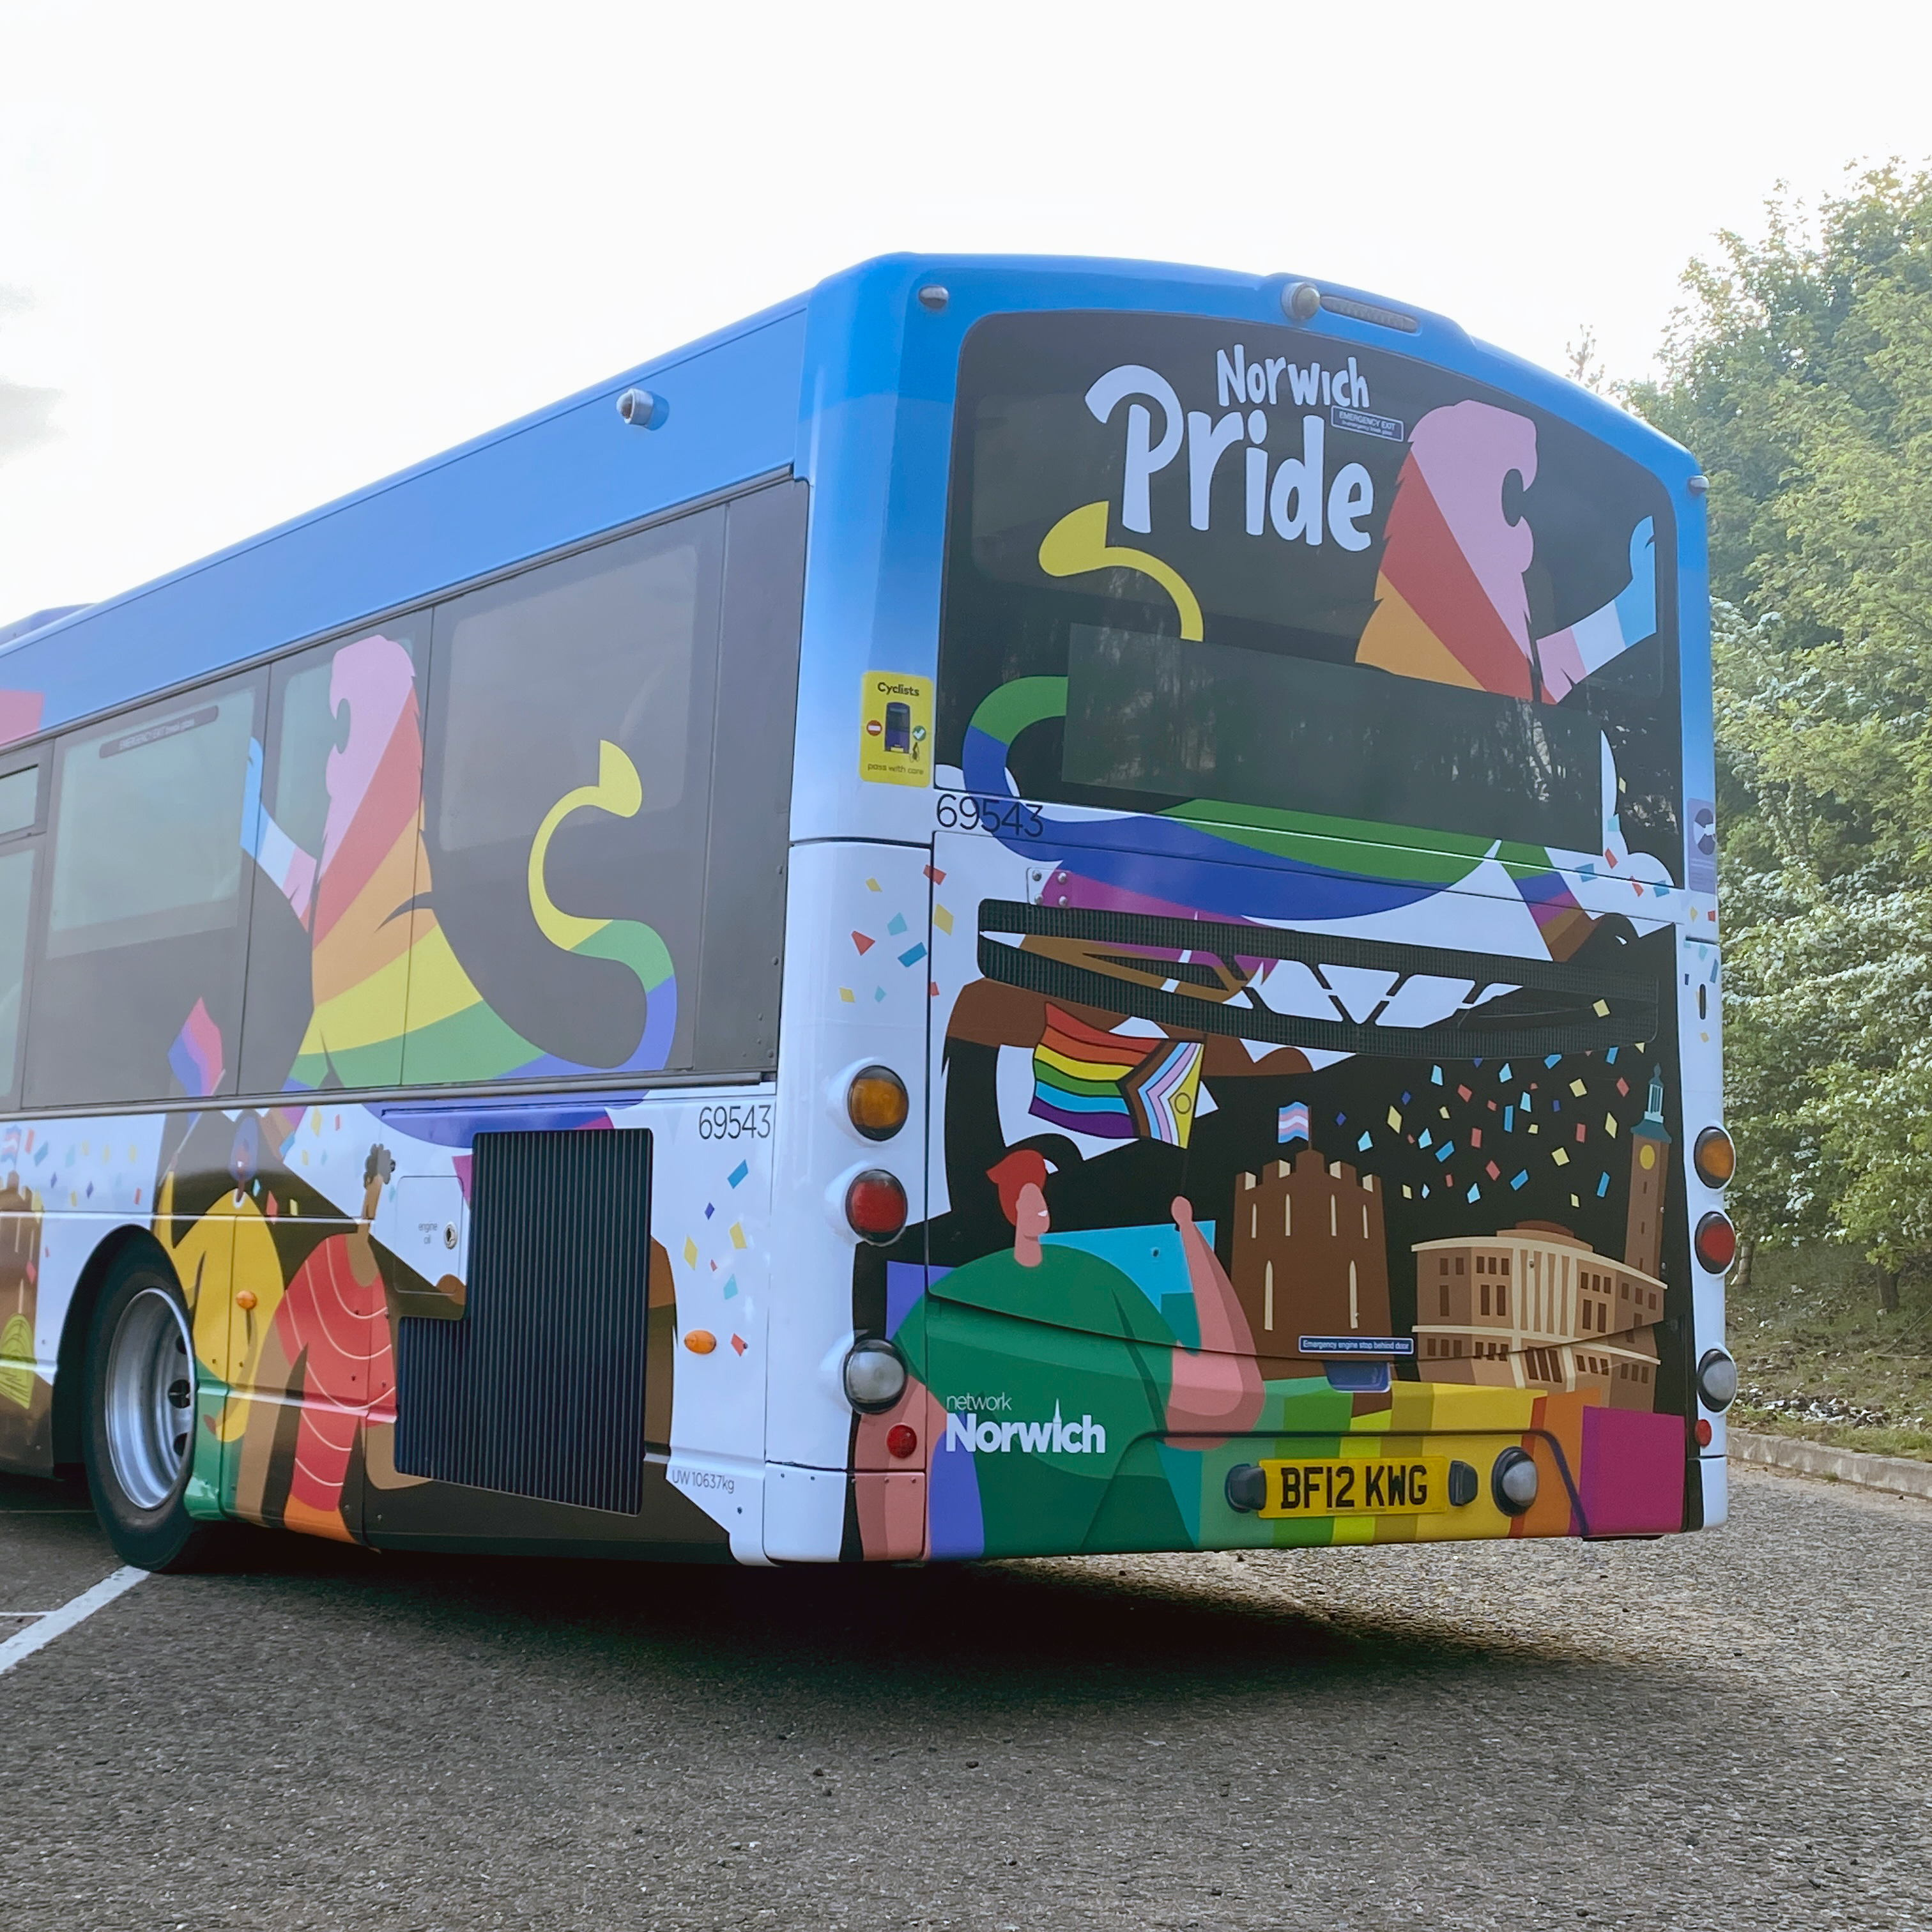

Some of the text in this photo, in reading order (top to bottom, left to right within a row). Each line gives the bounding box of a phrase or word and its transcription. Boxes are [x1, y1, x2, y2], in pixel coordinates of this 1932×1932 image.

[1216, 344, 1370, 408] Norwich
[1085, 364, 1374, 551] Pride
[877, 682, 919, 696] Cyclists
[937, 793, 1043, 837] 69543
[699, 1105, 771, 1140] 69543
[418, 1223, 438, 1232] engine
[1303, 1340, 1337, 1349] Emergency
[1338, 1342, 1358, 1350] engine
[1374, 1341, 1394, 1349] behind
[946, 1392, 1012, 1411] network
[946, 1398, 1106, 1453] Norwich
[672, 1469, 735, 1494] UW 10637kg
[1281, 1464, 1427, 1510] BF12 KWG
